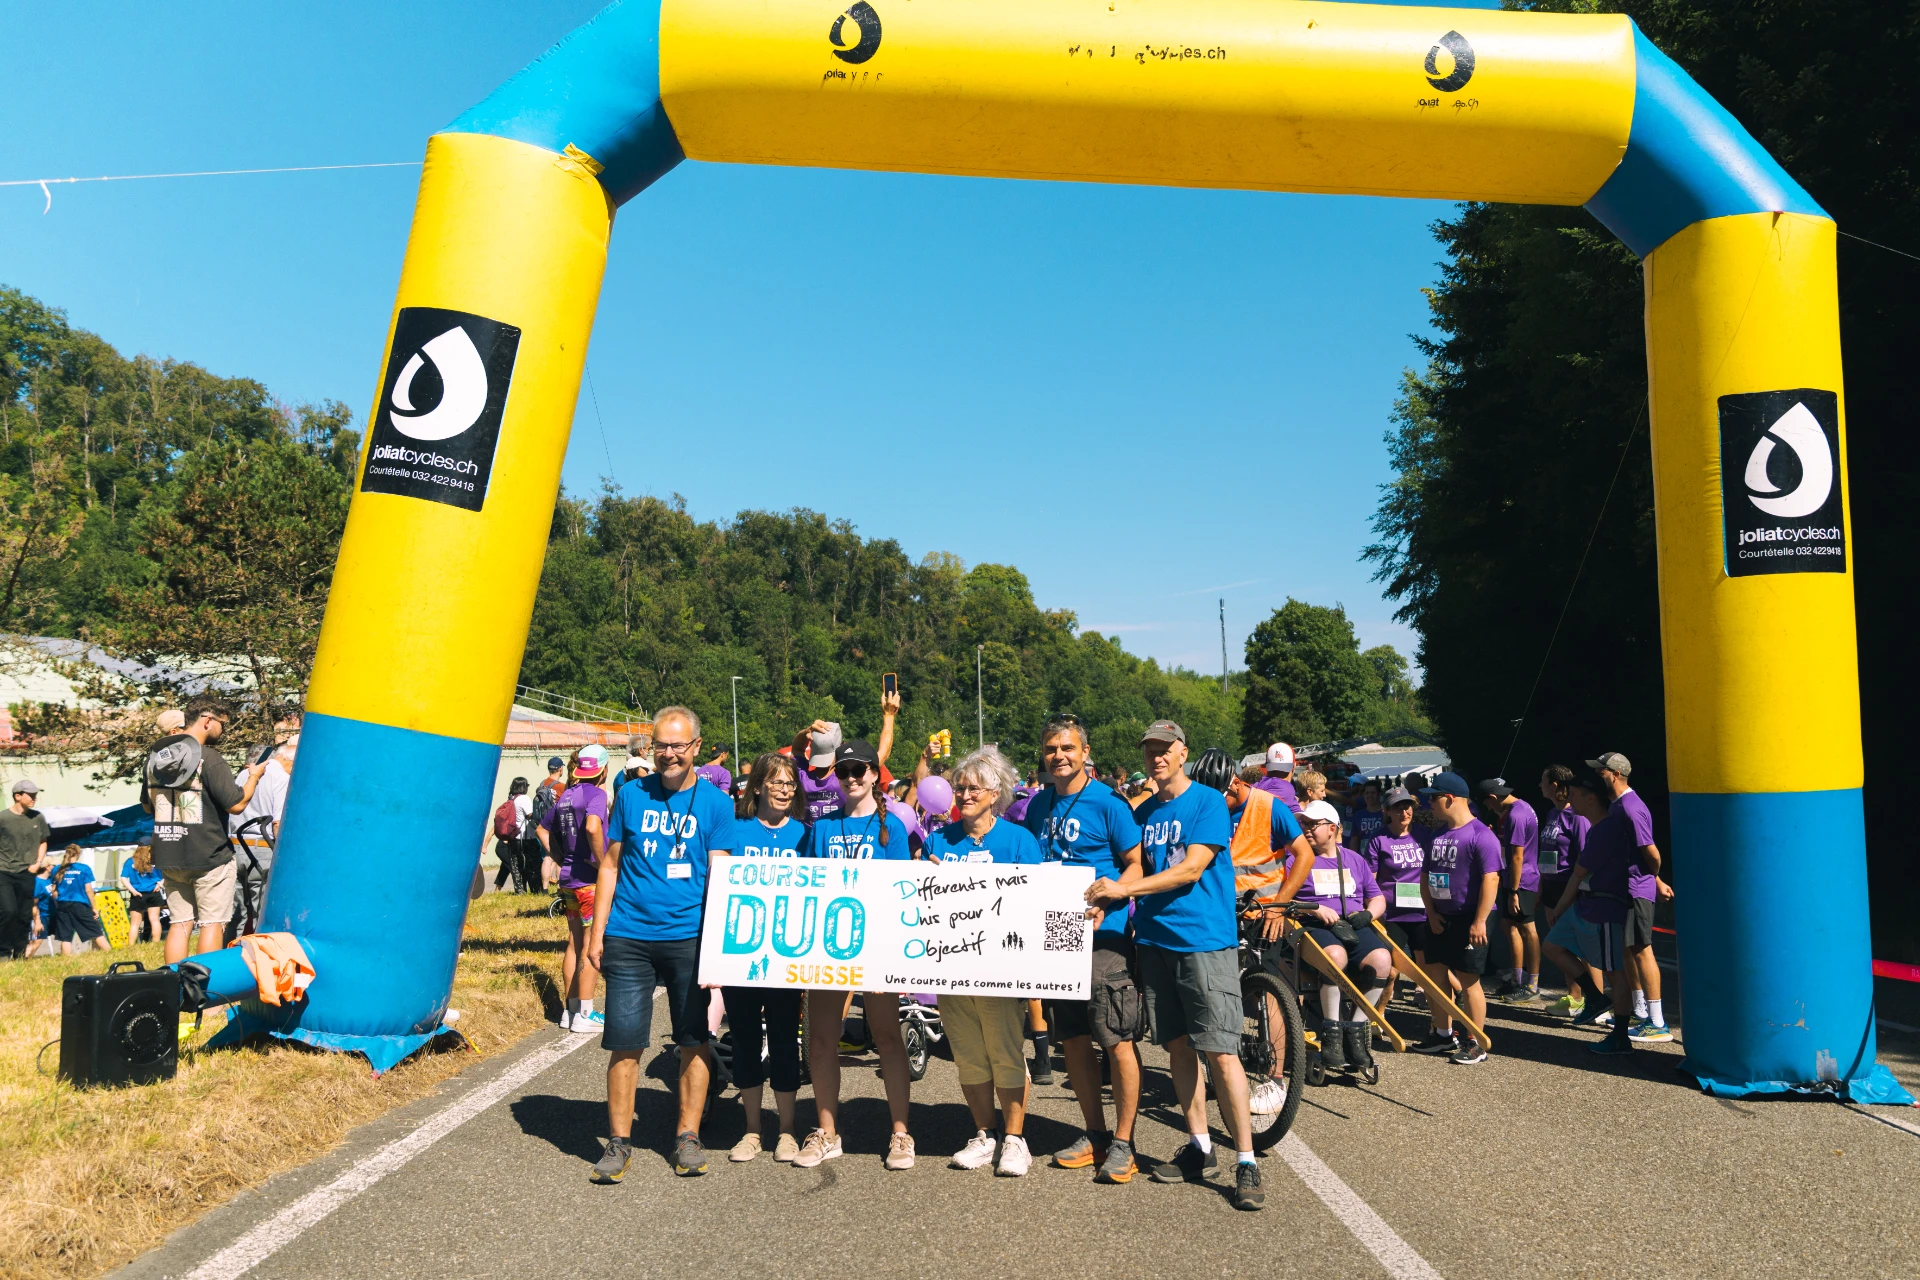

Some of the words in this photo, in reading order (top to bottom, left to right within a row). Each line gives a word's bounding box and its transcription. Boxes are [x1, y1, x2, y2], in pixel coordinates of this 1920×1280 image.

[372, 444, 478, 476] joliatcycles.ch
[369, 465, 411, 478] Courtételle
[412, 470, 430, 482] 032
[1738, 526, 1841, 546] joliatcycles.ch
[1738, 547, 1794, 559] Courtételle
[1796, 546, 1812, 555] 032
[641, 809, 698, 839] DUO
[1041, 816, 1081, 842] DUO
[1144, 819, 1182, 848] DUO
[829, 834, 863, 844] COURSE
[1392, 847, 1425, 865] DUO
[728, 863, 828, 888] COURSE
[892, 875, 987, 902] Differents
[995, 866, 1029, 890] mais
[1428, 872, 1446, 887] 34
[900, 905, 941, 927] Unis
[949, 907, 984, 929] pour
[990, 896, 1003, 917] 1
[721, 894, 867, 961] DUO
[903, 930, 987, 963] Objectif
[784, 963, 864, 986] SUISSE
[885, 974, 907, 985] Une
[910, 976, 948, 987] course
[950, 978, 970, 990] pas
[973, 978, 1013, 989] comme
[1016, 979, 1032, 990] les
[1035, 981, 1073, 992] autres
